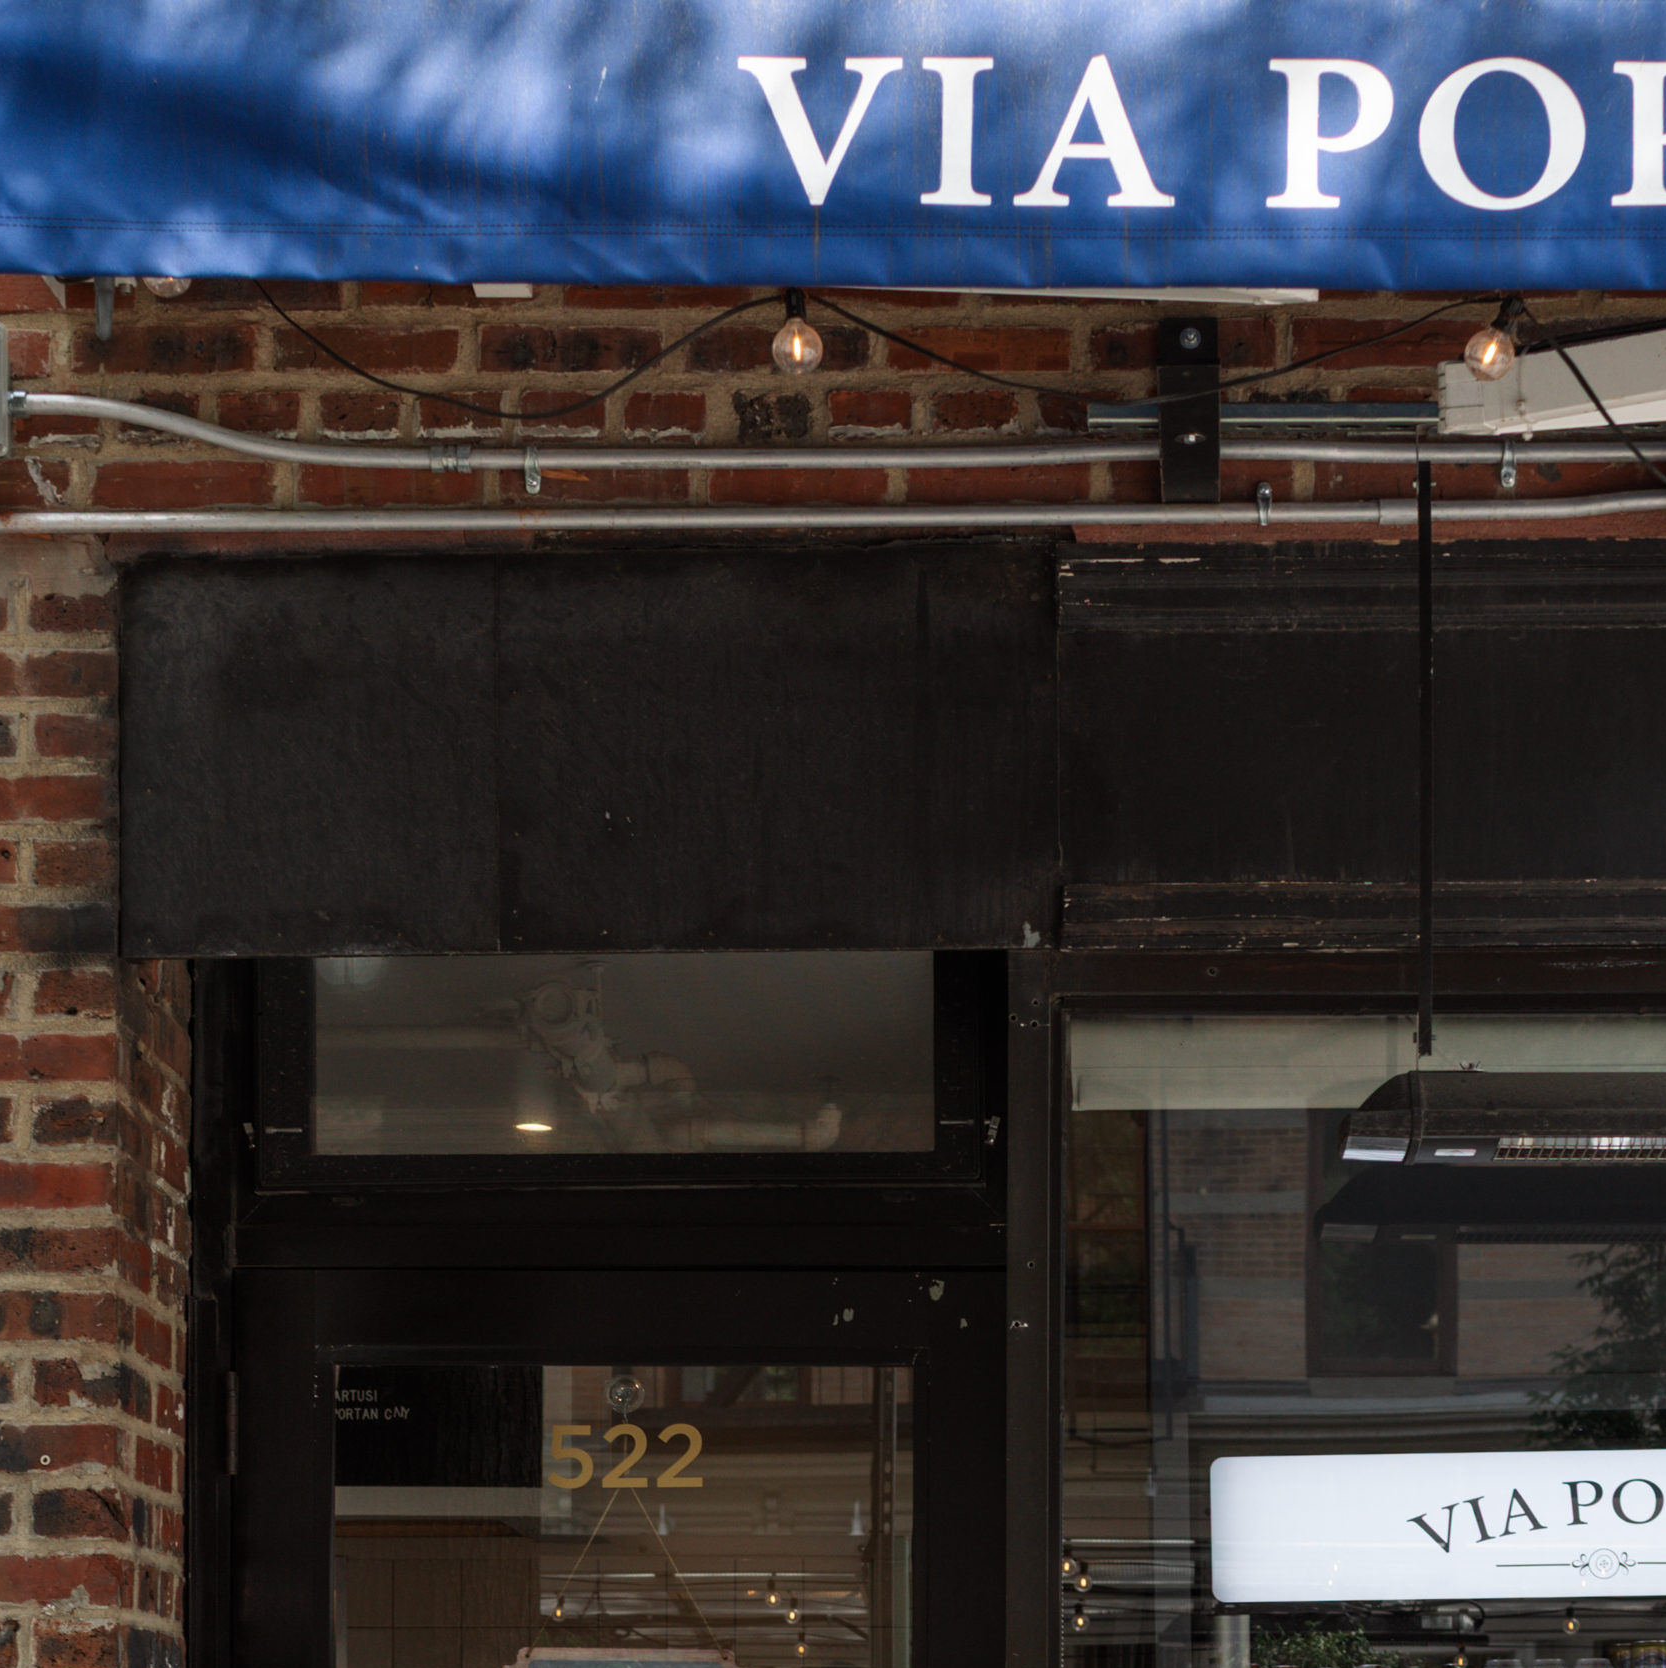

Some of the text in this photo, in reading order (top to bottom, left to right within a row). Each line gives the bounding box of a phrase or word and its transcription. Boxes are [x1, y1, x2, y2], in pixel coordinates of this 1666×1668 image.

[737, 53, 1175, 208] VIA
[547, 1422, 704, 1490] 522
[1406, 1486, 1548, 1554] VIA
